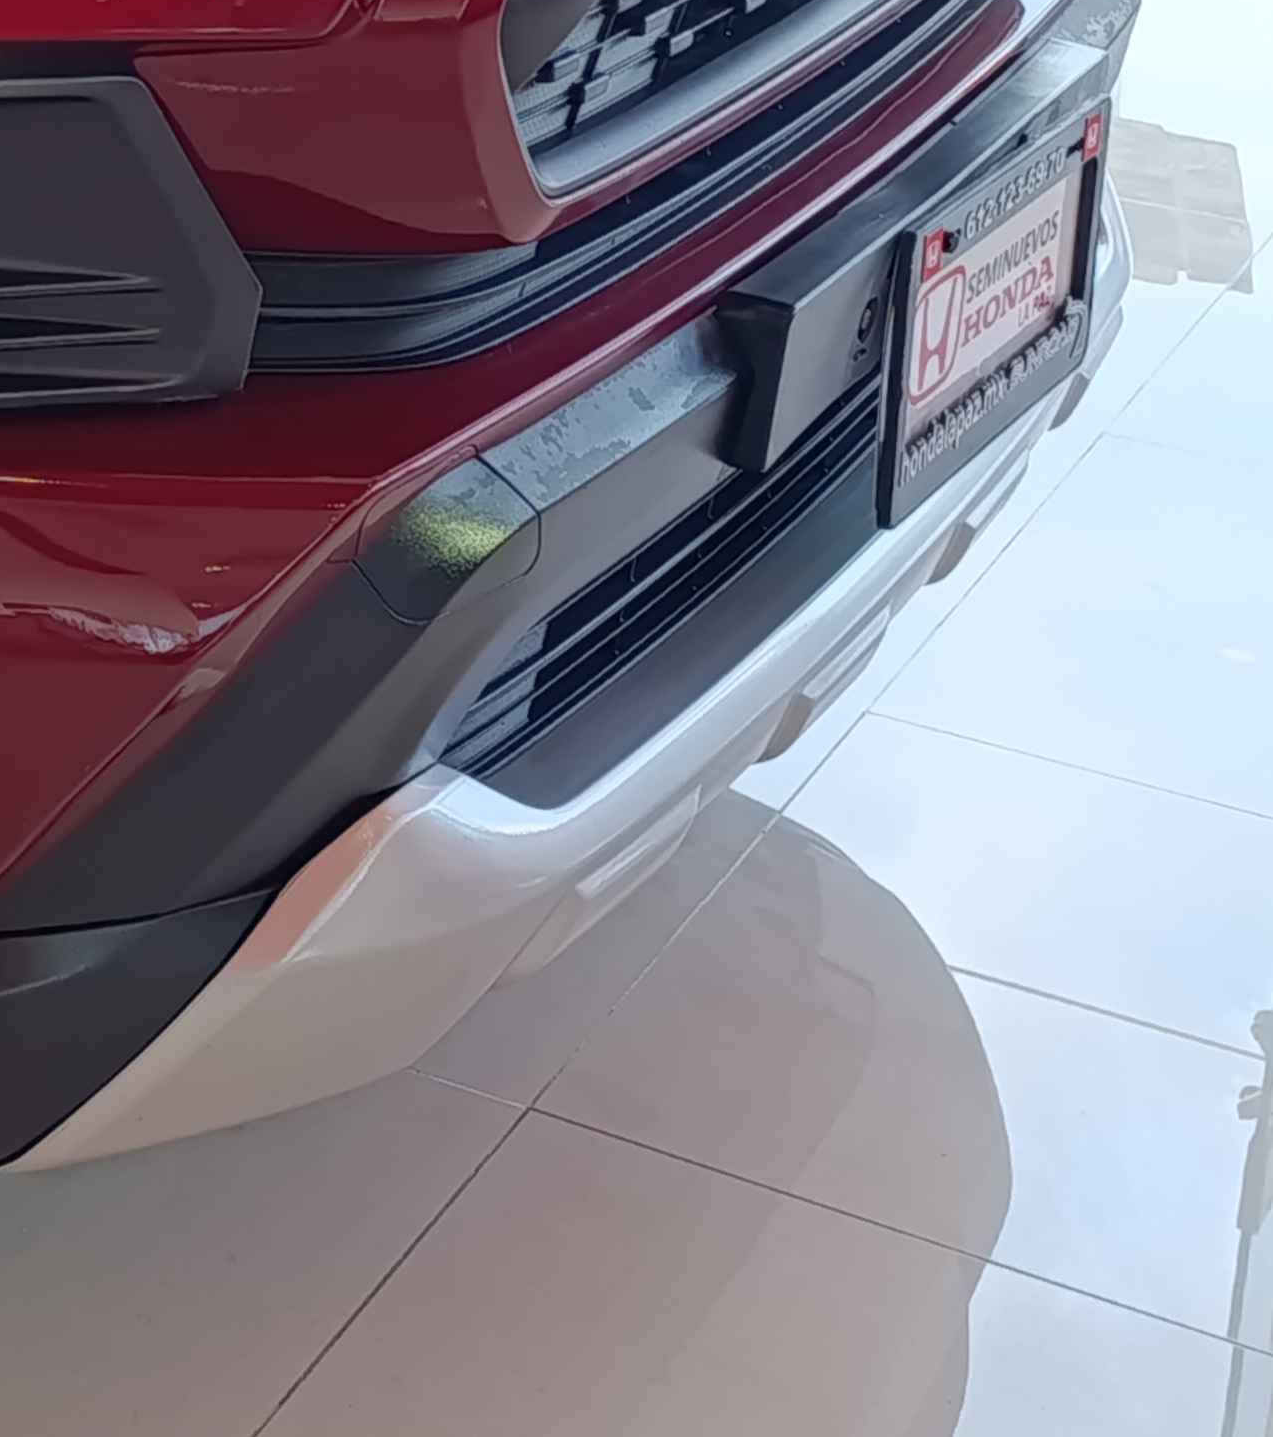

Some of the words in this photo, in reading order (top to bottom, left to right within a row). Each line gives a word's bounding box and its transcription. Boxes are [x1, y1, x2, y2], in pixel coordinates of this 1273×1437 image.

[960, 254, 1054, 349] HONDA
[966, 209, 1060, 305] SEMINUEVOS
[1017, 302, 1030, 328] LA
